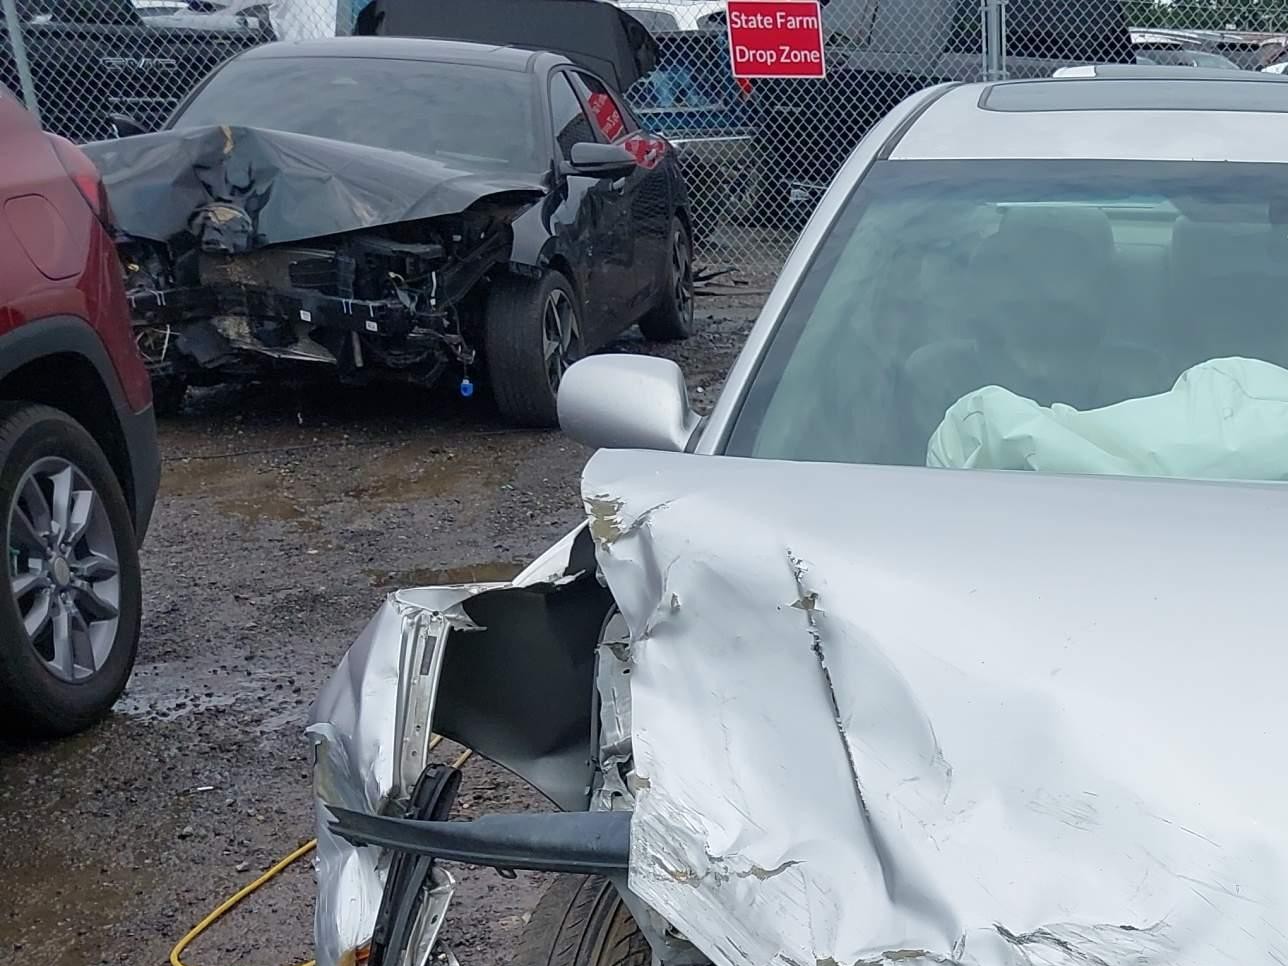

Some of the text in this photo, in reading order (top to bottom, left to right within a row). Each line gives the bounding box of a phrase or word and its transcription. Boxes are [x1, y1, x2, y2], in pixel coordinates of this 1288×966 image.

[731, 11, 818, 29] State Farm
[735, 46, 820, 66] Drop Zone
